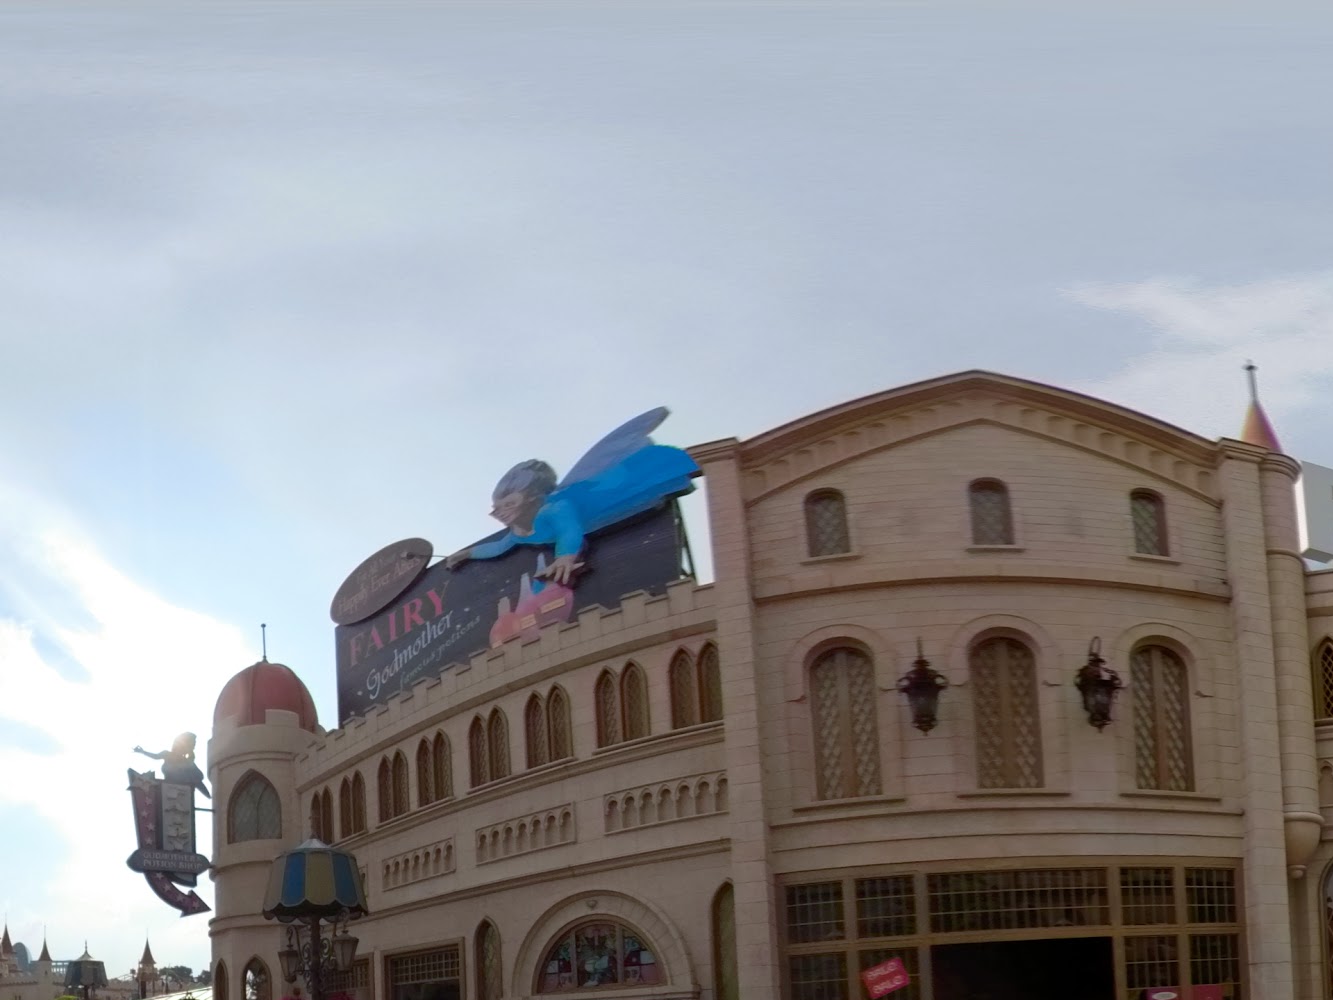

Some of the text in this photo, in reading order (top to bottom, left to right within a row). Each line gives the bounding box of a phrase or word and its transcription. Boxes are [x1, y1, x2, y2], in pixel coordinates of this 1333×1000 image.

[349, 580, 450, 667] FAIRY
[365, 609, 454, 700] Godmother
[143, 859, 203, 870] POTION SHOP
